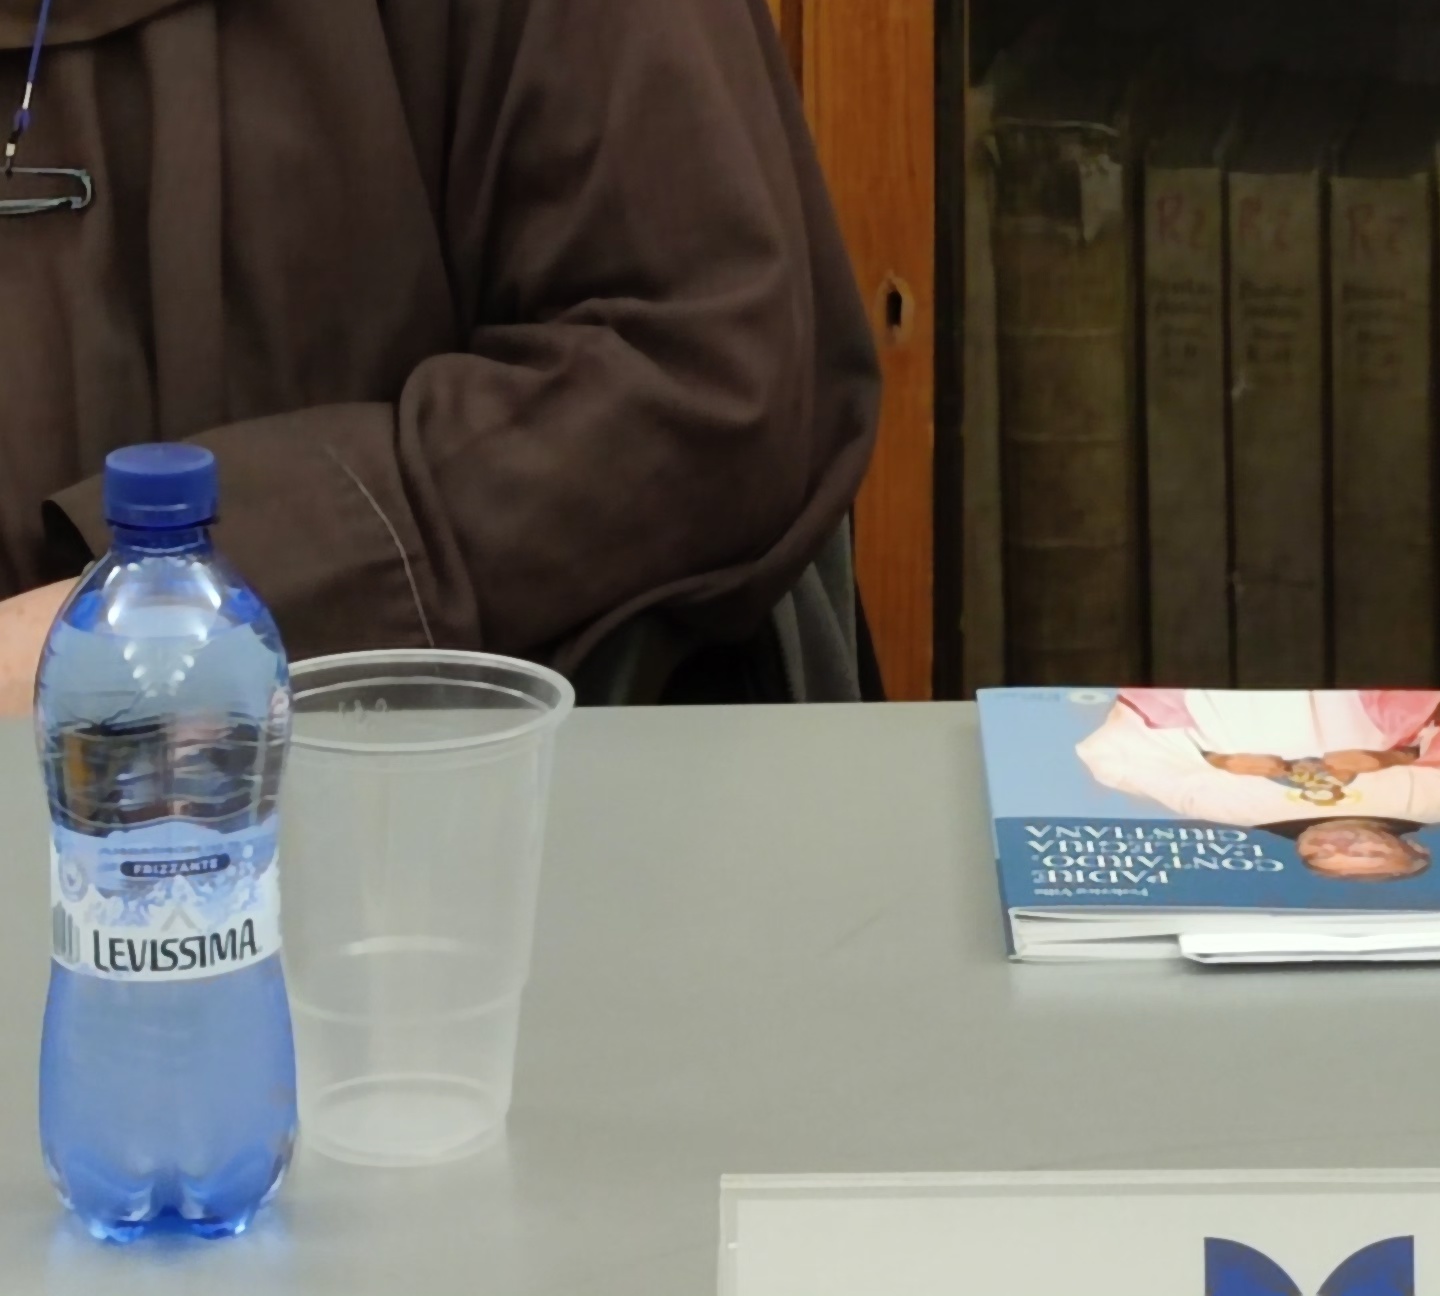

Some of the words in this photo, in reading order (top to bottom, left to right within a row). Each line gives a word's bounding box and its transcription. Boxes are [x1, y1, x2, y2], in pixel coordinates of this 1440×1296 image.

[132, 858, 219, 876] FRIZZANTE
[1031, 869, 1169, 884] PADRE
[92, 917, 259, 974] LEVISSIMA
